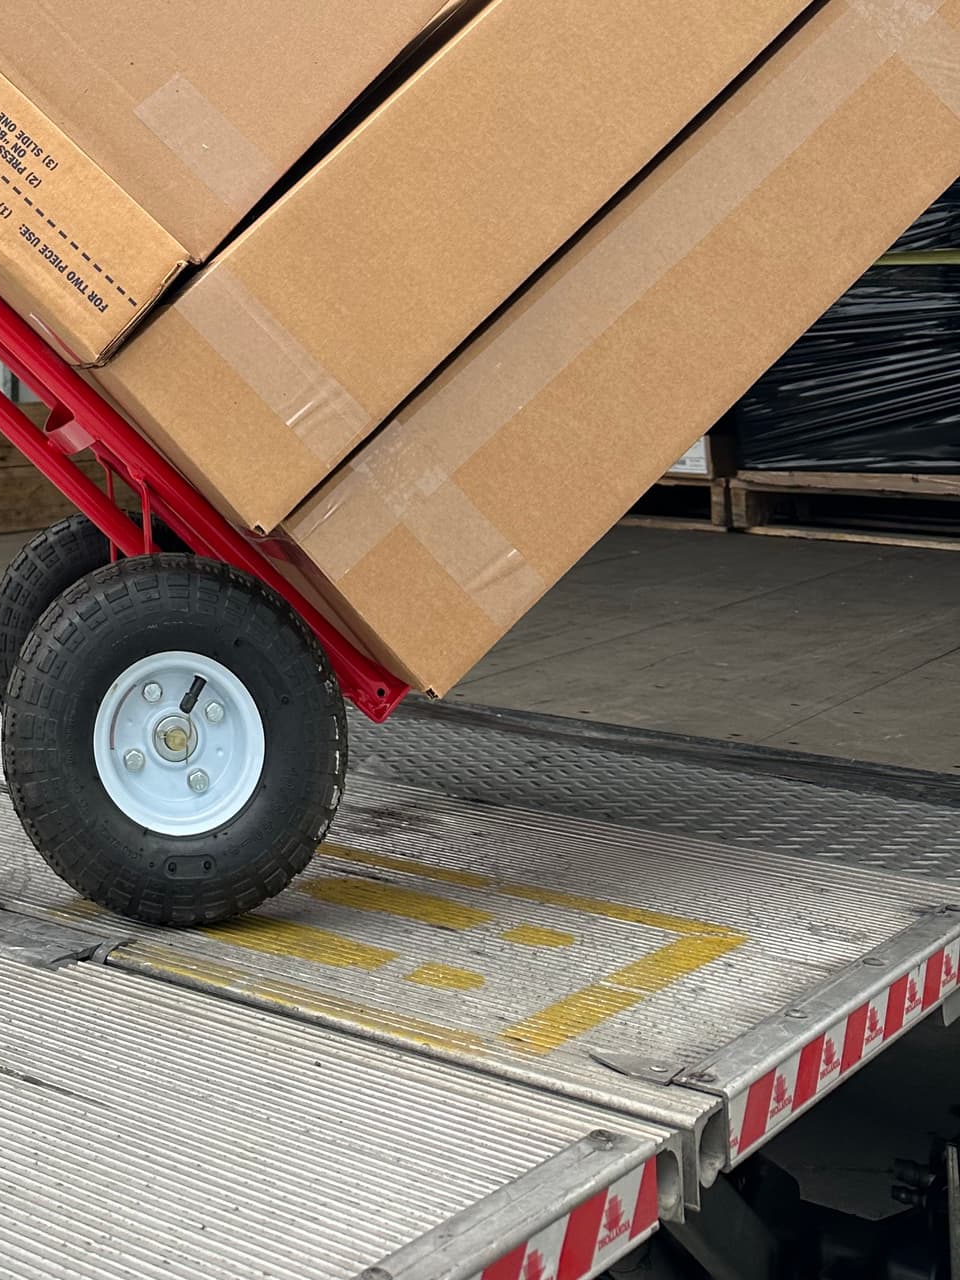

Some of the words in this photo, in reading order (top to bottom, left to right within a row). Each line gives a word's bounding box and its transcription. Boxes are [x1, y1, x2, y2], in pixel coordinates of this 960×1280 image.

[10, 142, 27, 159] ON
[14, 129, 44, 158] SLIDE
[41, 154, 59, 172] (3)
[25, 171, 42, 189] (2)
[18, 223, 41, 248] USE:
[38, 243, 69, 274] PIECE
[66, 271, 89, 296] TWO
[87, 290, 109, 313] FOR
